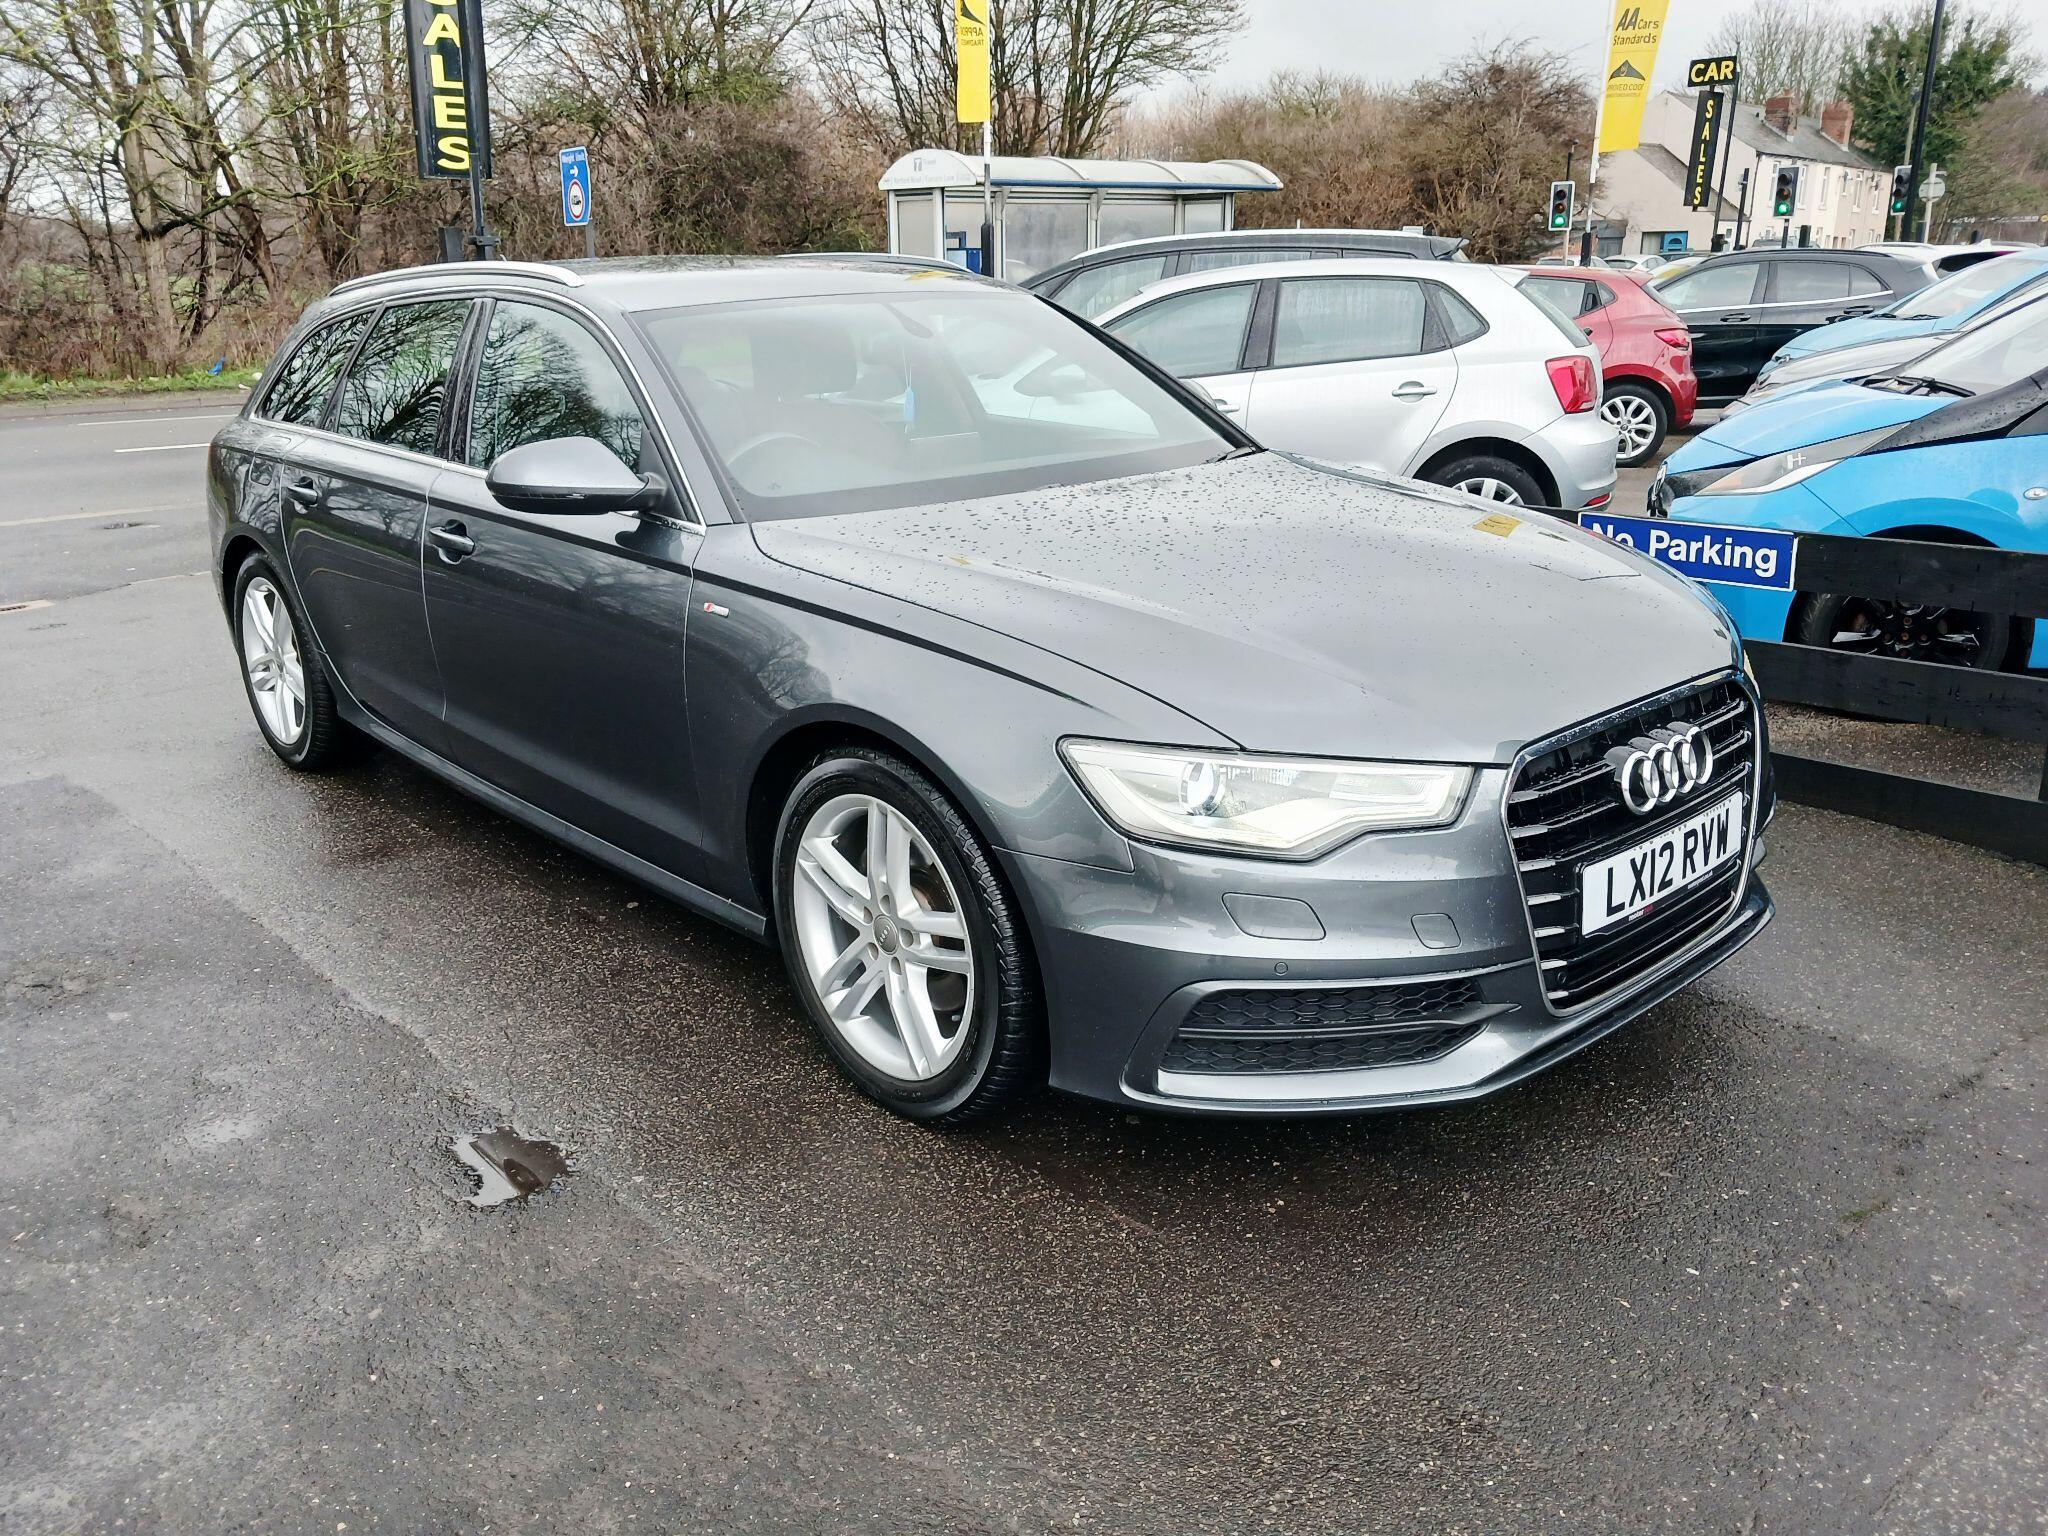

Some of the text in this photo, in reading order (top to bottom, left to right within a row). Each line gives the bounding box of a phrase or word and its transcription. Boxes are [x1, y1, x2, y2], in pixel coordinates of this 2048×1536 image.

[1612, 33, 1657, 46] Standards
[1616, 7, 1660, 31] AA Cars
[423, 0, 470, 170] ALES
[1690, 60, 1734, 83] CAR
[1693, 99, 1714, 206] SALES
[1649, 529, 1778, 578] Parking
[1606, 807, 1730, 918] LX12 RVW
